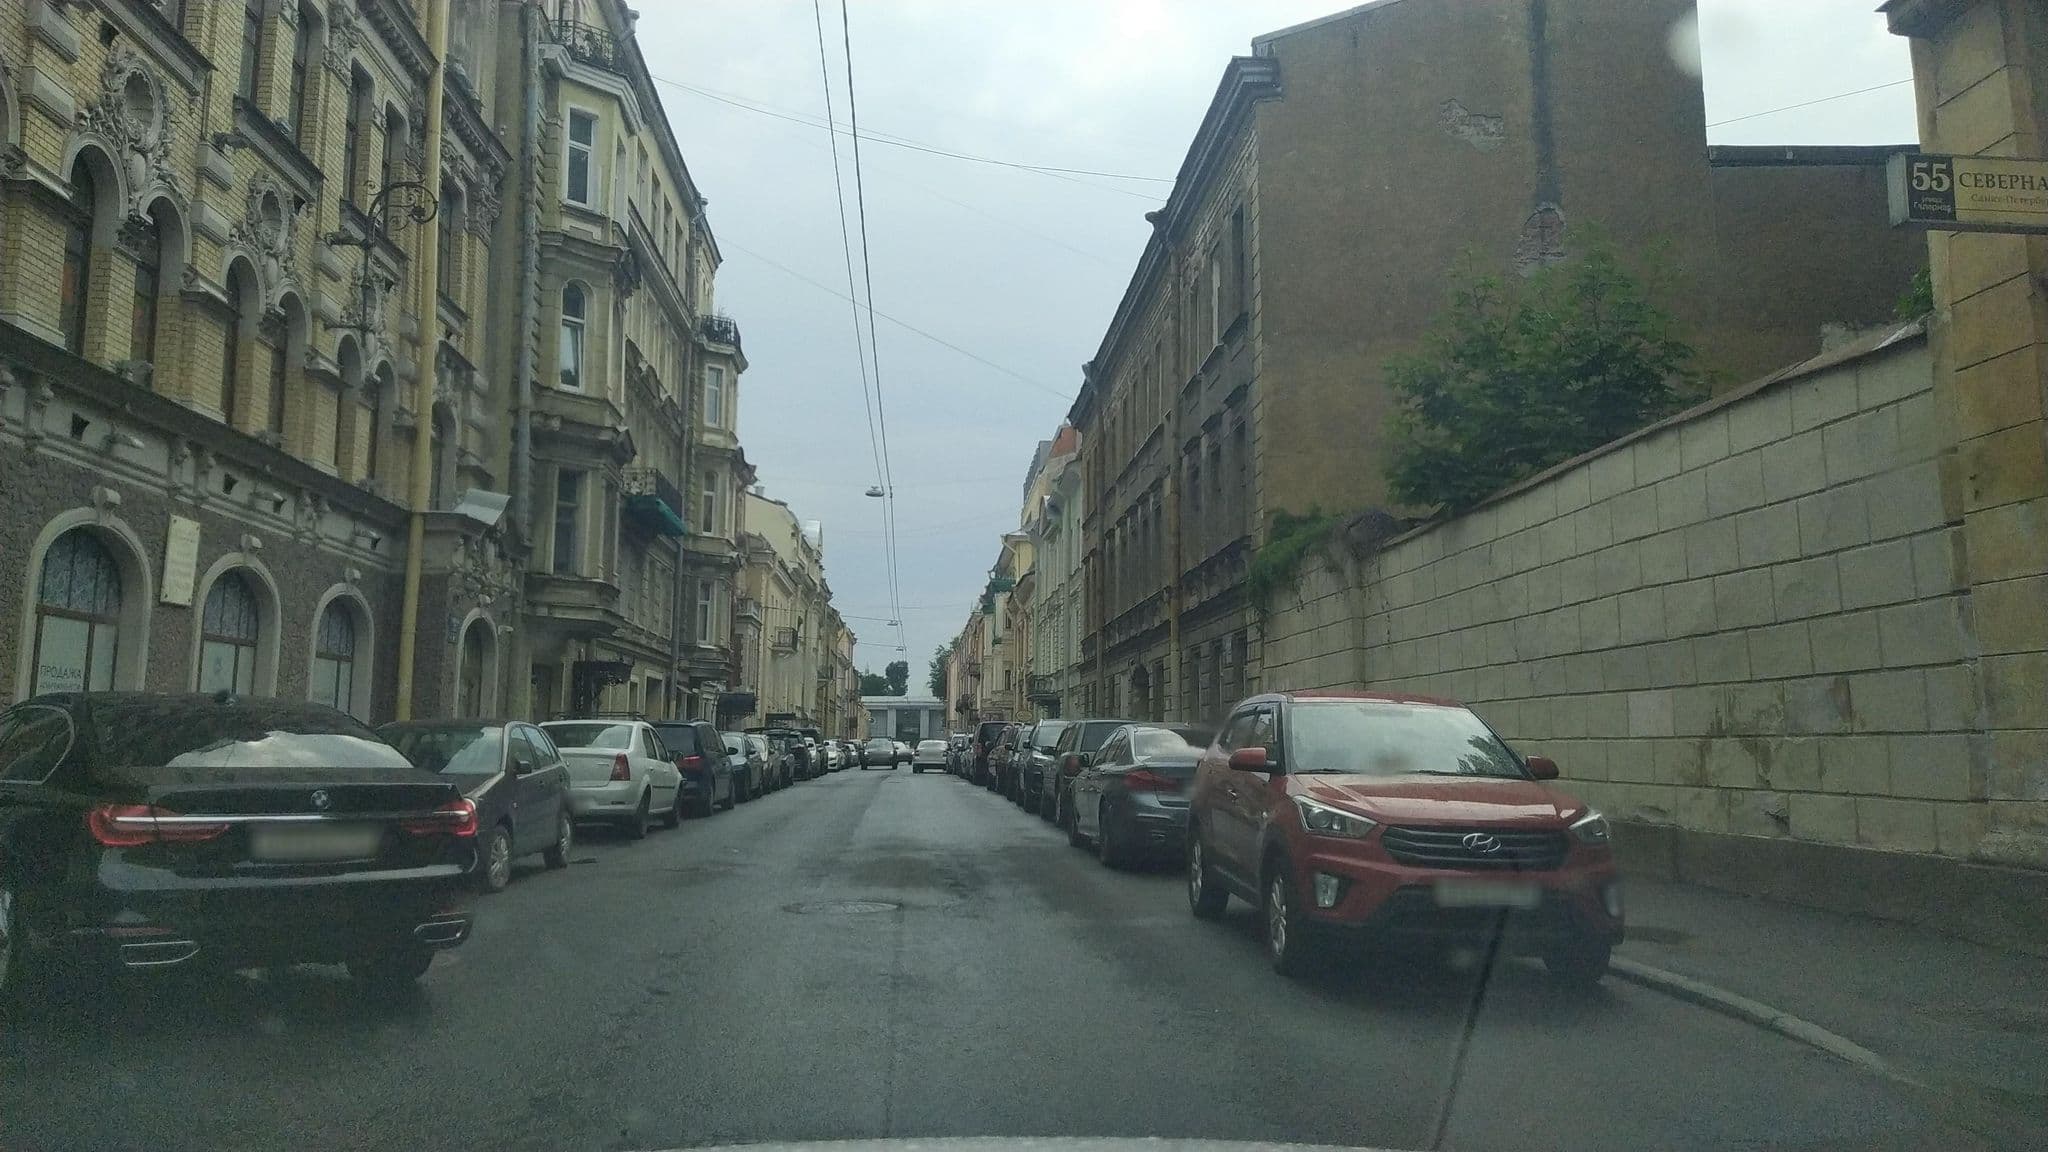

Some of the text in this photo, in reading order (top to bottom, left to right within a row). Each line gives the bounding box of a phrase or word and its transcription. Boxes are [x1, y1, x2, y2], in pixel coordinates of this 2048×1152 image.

[1912, 161, 1951, 192] 55
[1959, 172, 2048, 191] СЕВЕРНА
[40, 665, 82, 680] ПРОДАЖА
